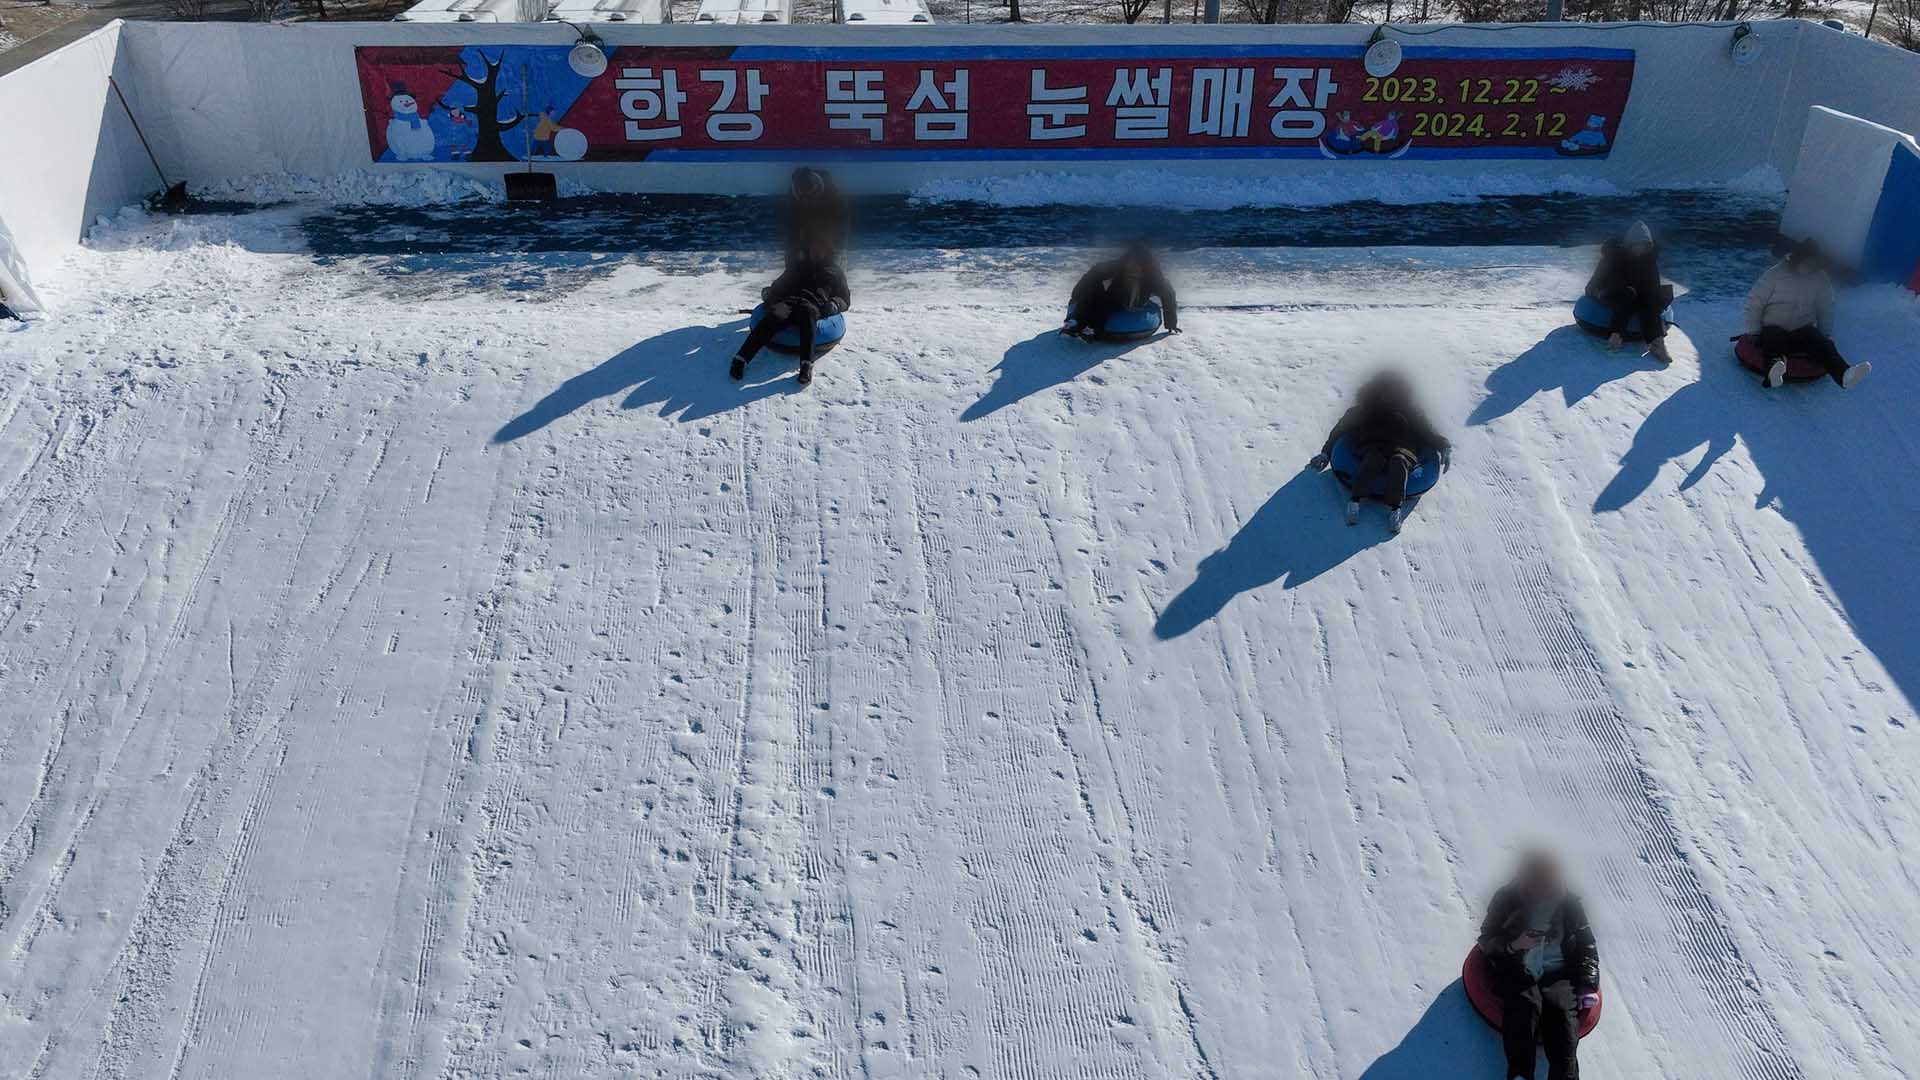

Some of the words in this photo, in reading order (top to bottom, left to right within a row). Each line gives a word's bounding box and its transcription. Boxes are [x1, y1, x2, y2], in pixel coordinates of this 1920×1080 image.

[1362, 77, 1445, 104] 2023.
[1458, 79, 1540, 104] 12.22
[615, 68, 770, 142] 한강
[824, 69, 970, 141] 뚝섬
[1026, 67, 1339, 140] 눈썰매장
[1411, 112, 1493, 139] 2024.
[1502, 112, 1567, 138] 2.12
